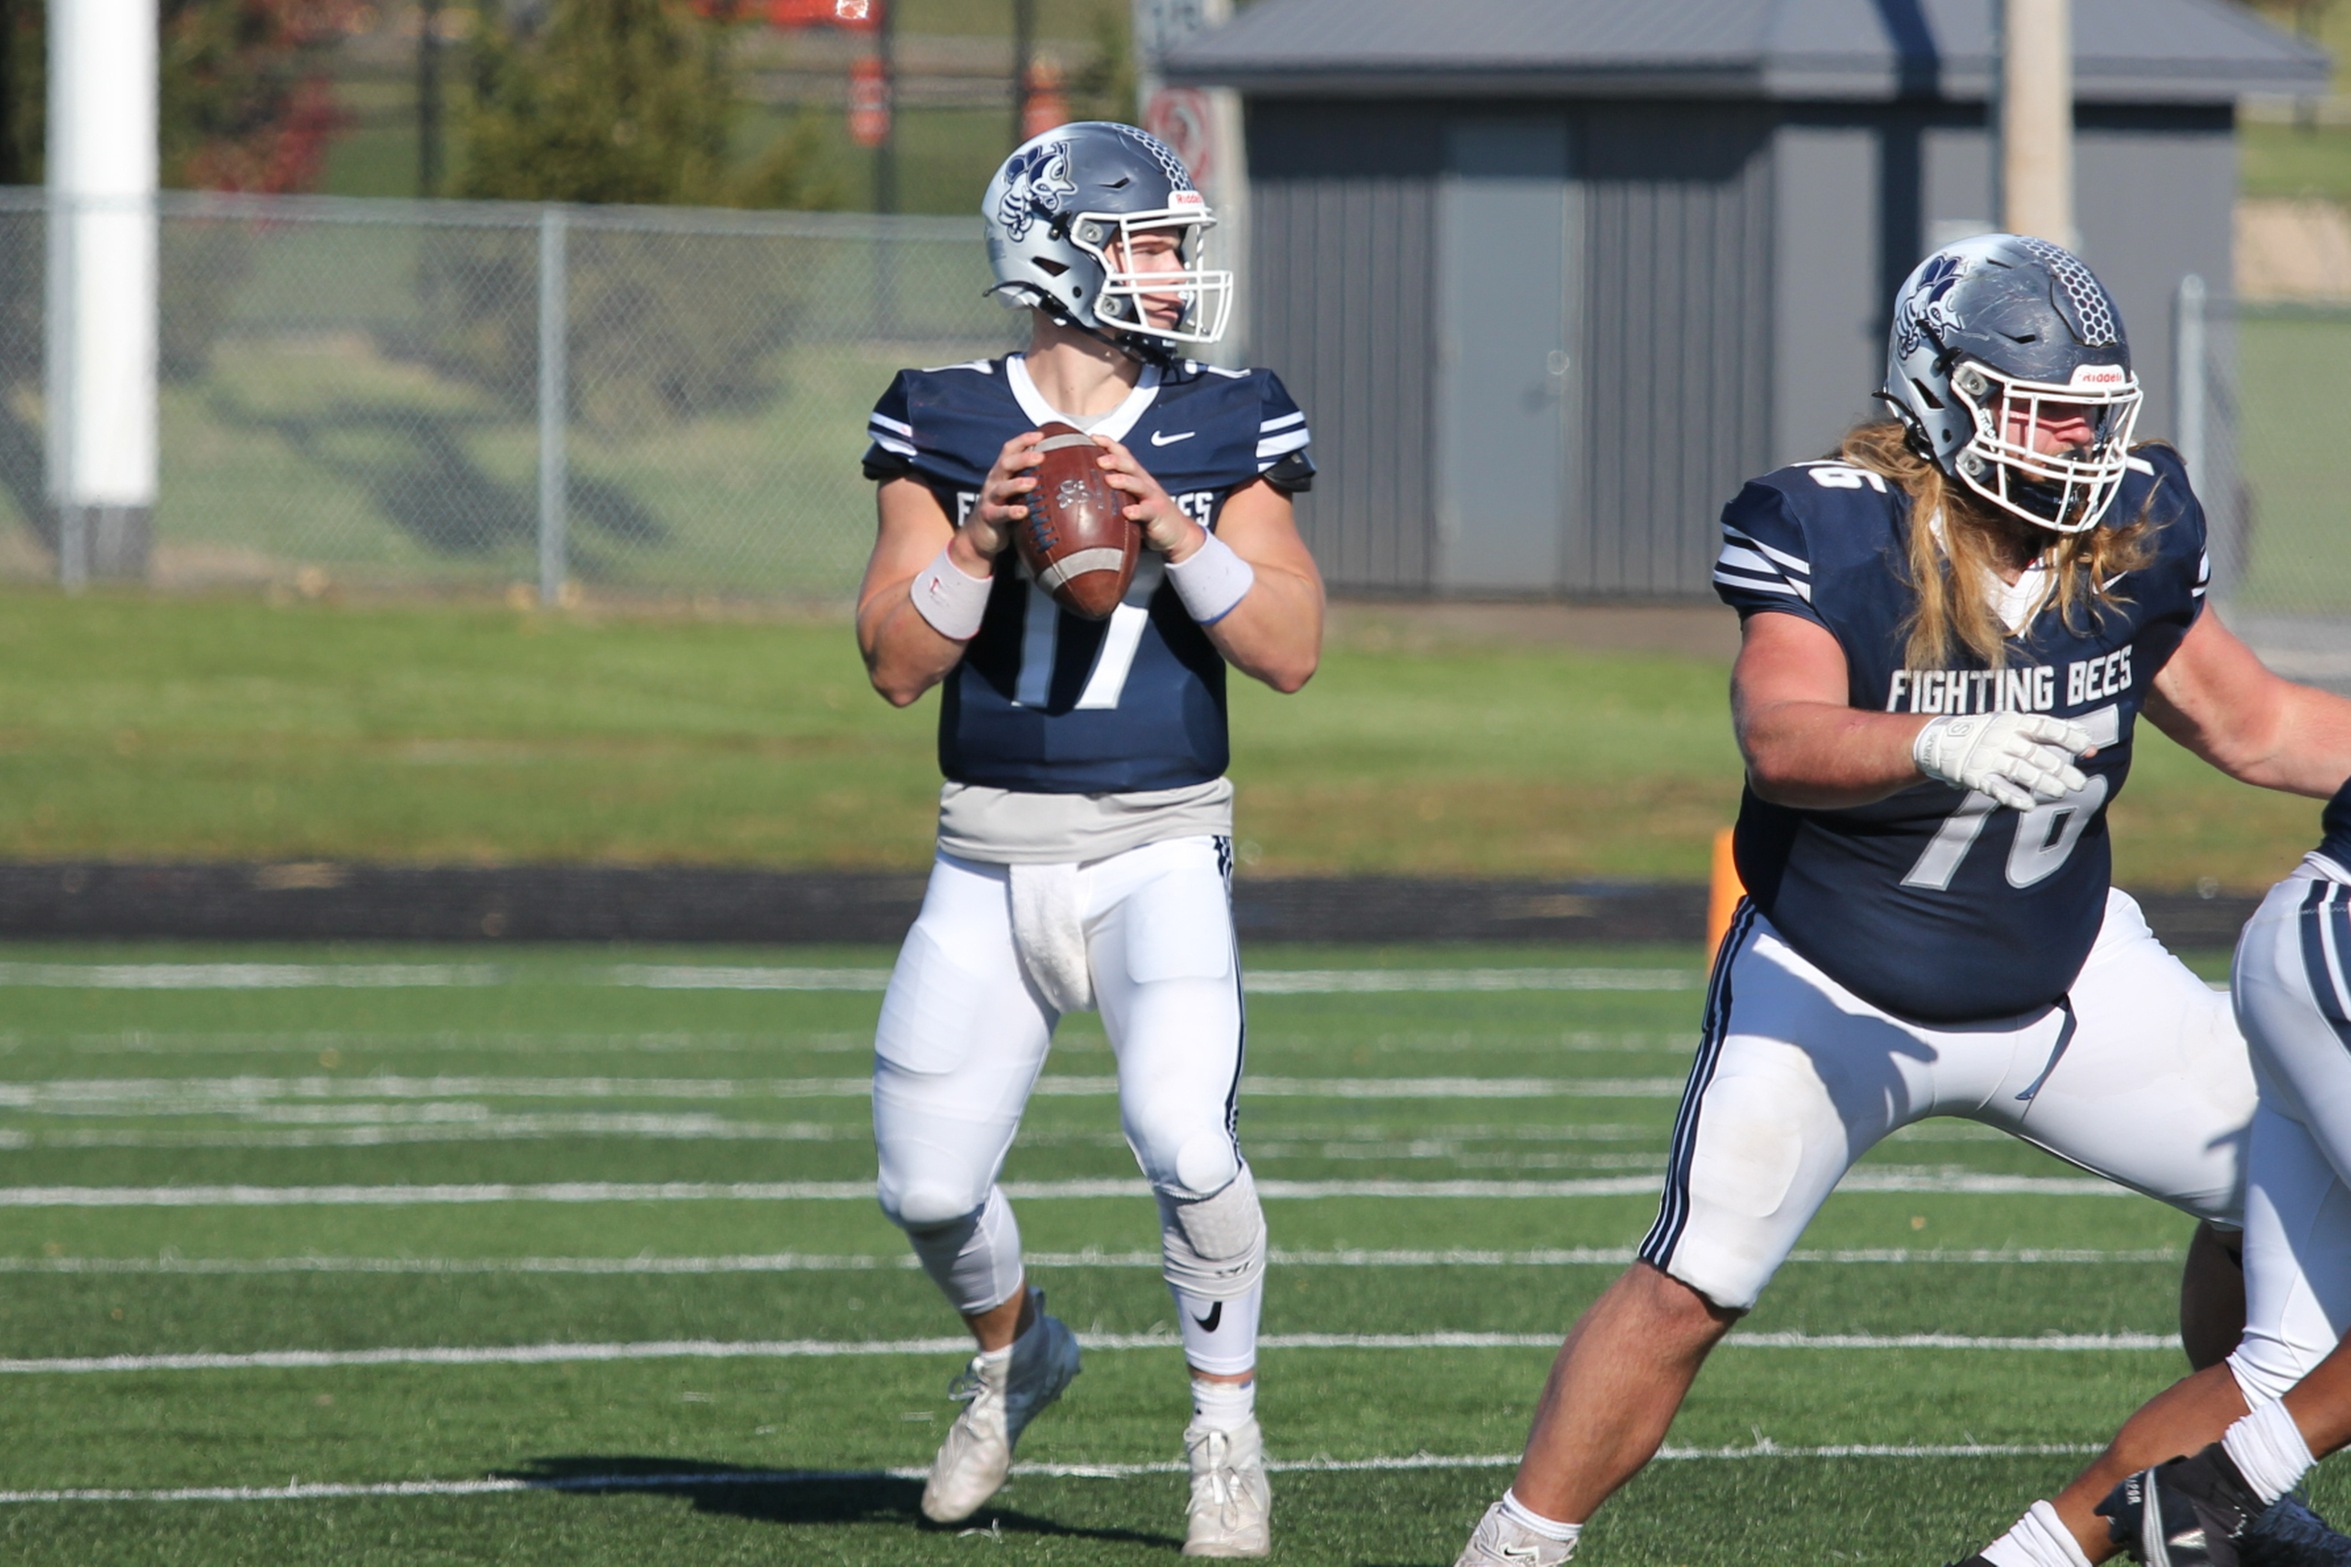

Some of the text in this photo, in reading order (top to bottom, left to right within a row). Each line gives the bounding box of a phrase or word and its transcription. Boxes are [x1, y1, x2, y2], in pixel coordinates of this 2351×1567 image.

[1169, 491, 1214, 528] ES
[1011, 548, 1165, 709] 17
[1886, 644, 2133, 714] FIGHTING BEES
